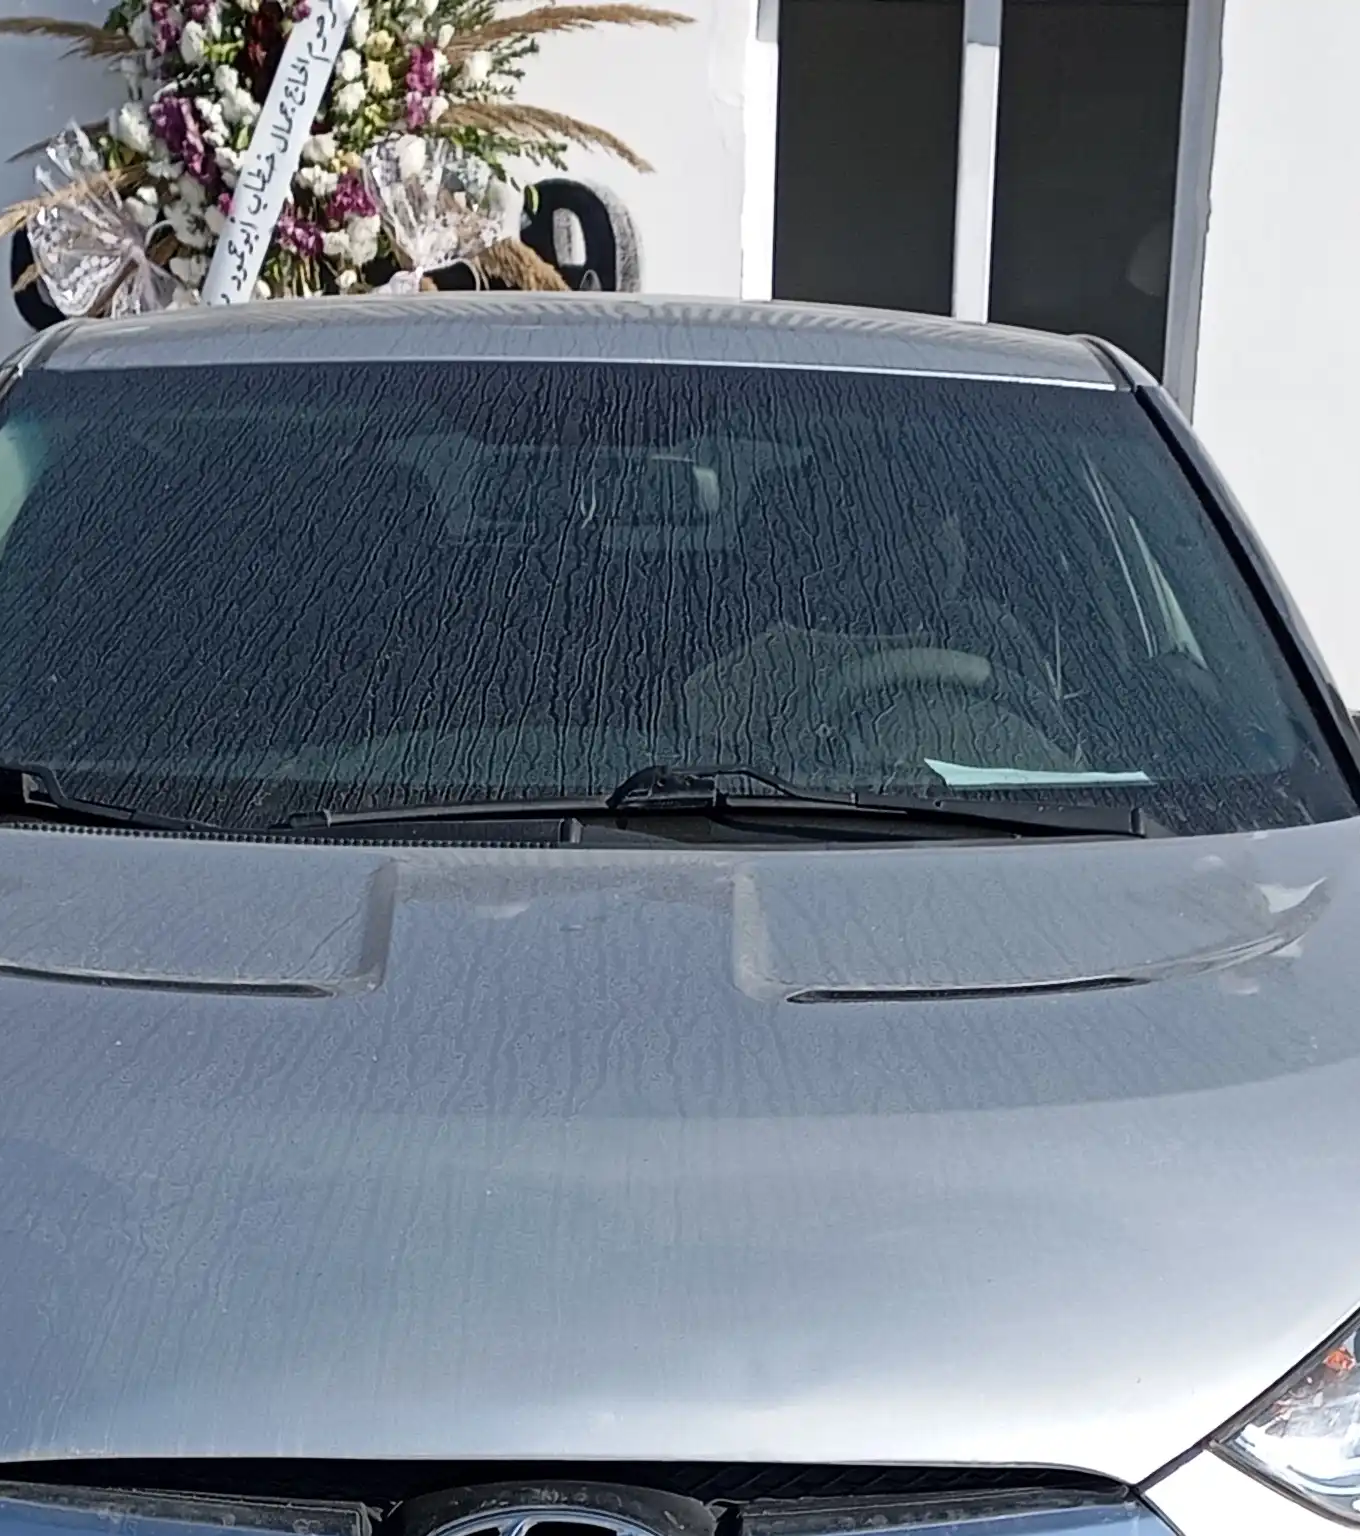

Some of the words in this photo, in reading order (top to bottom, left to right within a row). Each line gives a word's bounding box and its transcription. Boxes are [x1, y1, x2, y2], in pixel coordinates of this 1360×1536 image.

[284, 56, 309, 106] الحاج
[270, 101, 297, 154] جمال
[242, 152, 276, 216] خطاب
[229, 215, 260, 255] أبو
